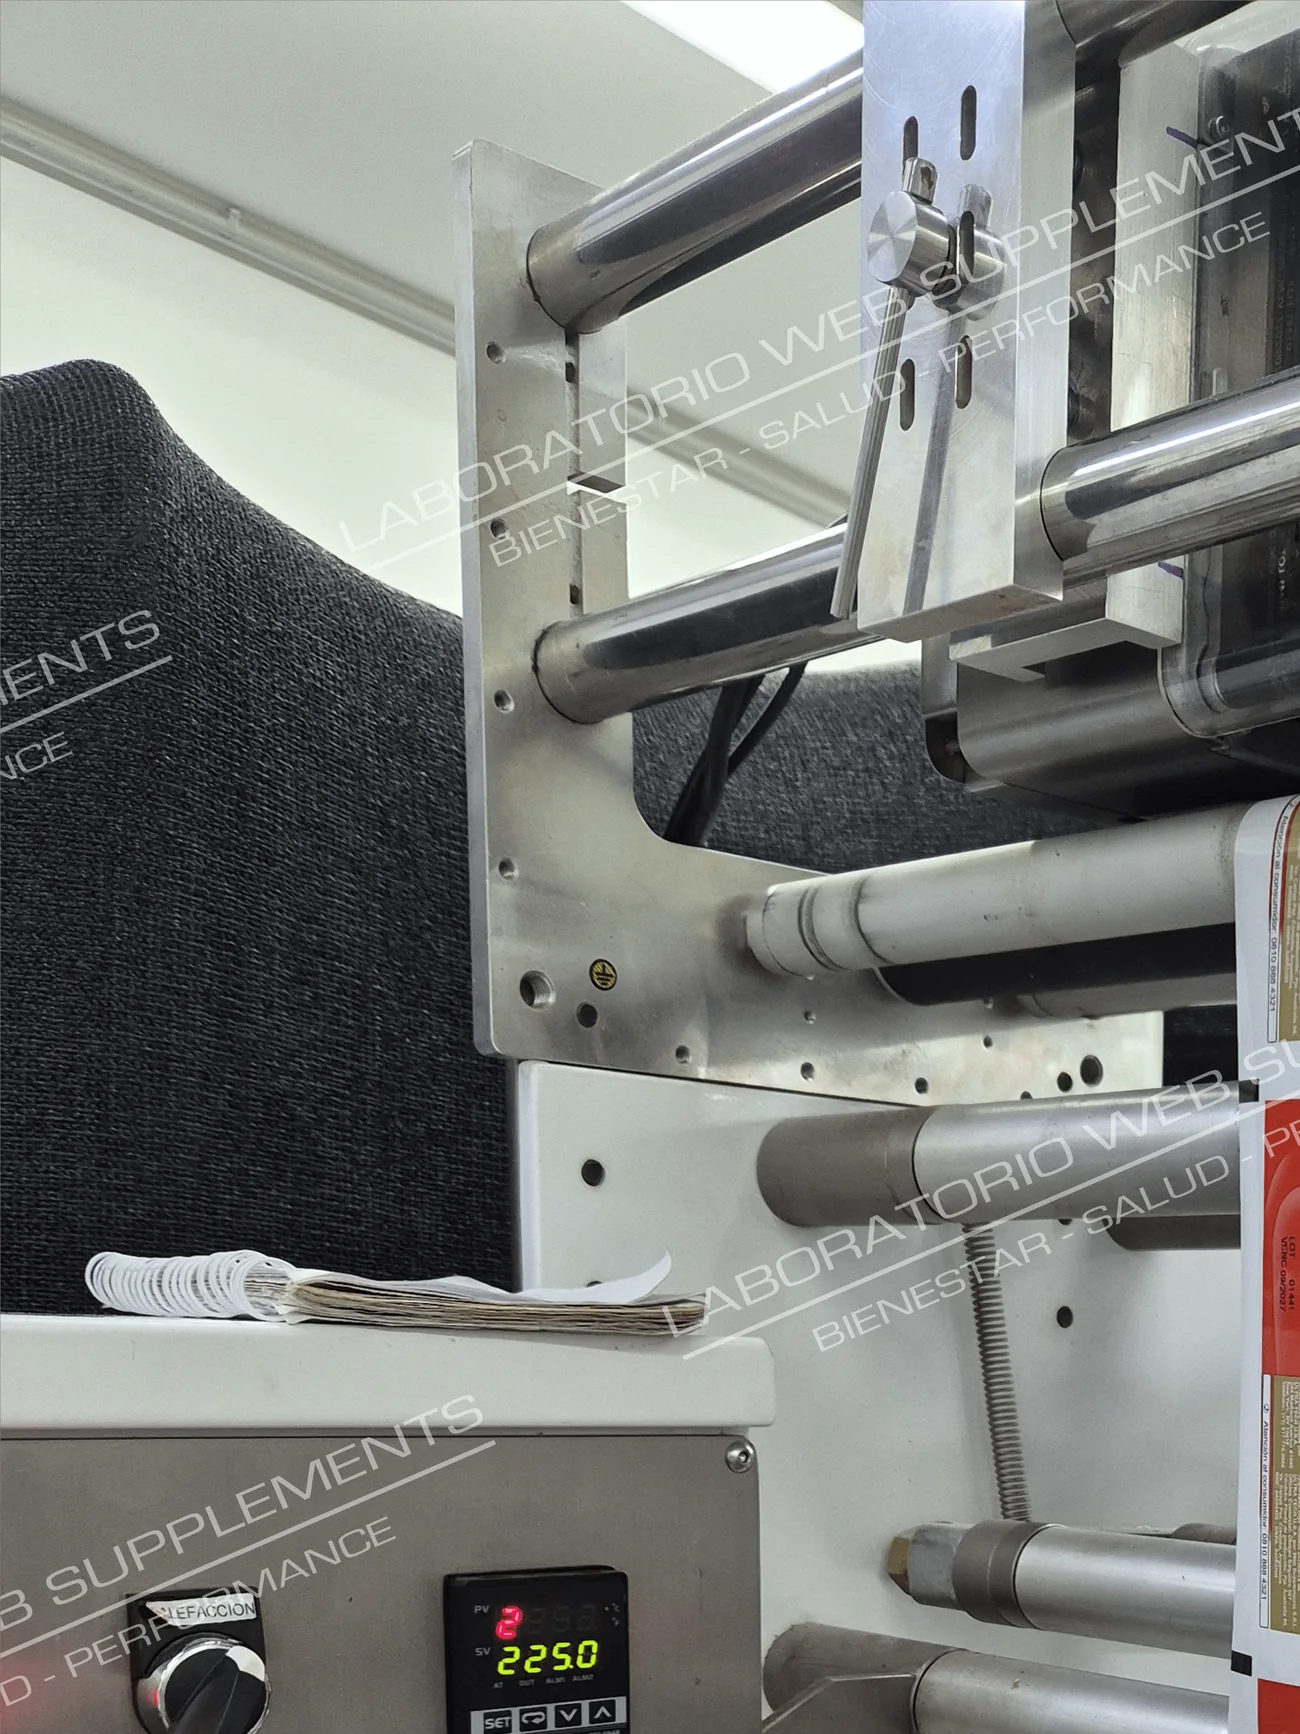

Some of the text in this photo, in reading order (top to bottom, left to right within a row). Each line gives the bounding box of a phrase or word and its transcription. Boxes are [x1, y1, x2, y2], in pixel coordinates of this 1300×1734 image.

[1278, 1269, 1287, 1312] 09/2027
[474, 1604, 490, 1614] PV
[475, 1647, 491, 1657] SV
[484, 1716, 512, 1730] SET
